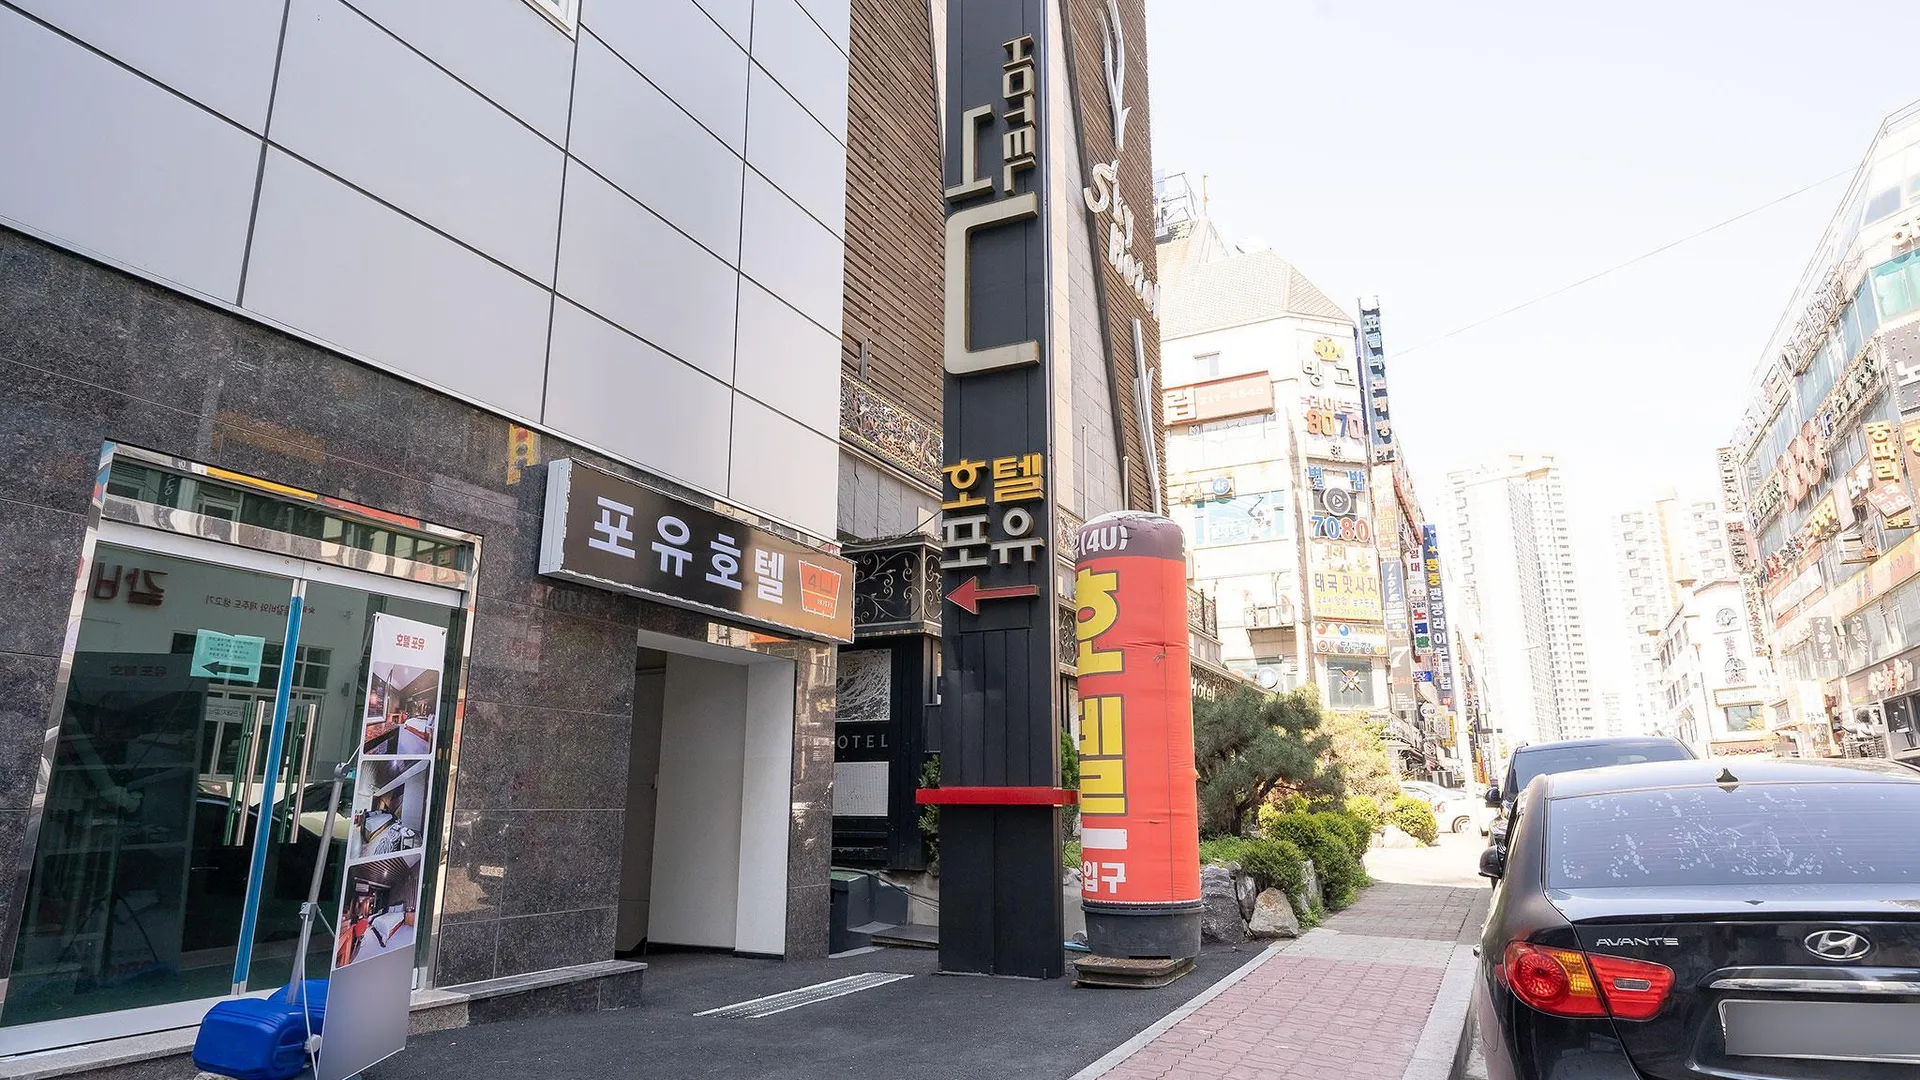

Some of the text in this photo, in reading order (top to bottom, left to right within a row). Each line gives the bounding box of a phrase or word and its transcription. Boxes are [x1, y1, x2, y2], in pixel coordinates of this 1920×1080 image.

[1003, 33, 1036, 196] HOTEL
[1306, 408, 1364, 440] 8070
[942, 452, 1044, 508] 호텔
[940, 507, 1044, 570] 포유
[1310, 514, 1371, 543] 7080
[588, 496, 785, 605] 포유호텔
[396, 632, 425, 651] 호텔 포유
[1191, 677, 1215, 702] Hotel
[837, 733, 889, 749] OTEL
[1596, 936, 1679, 947] AVANTE
